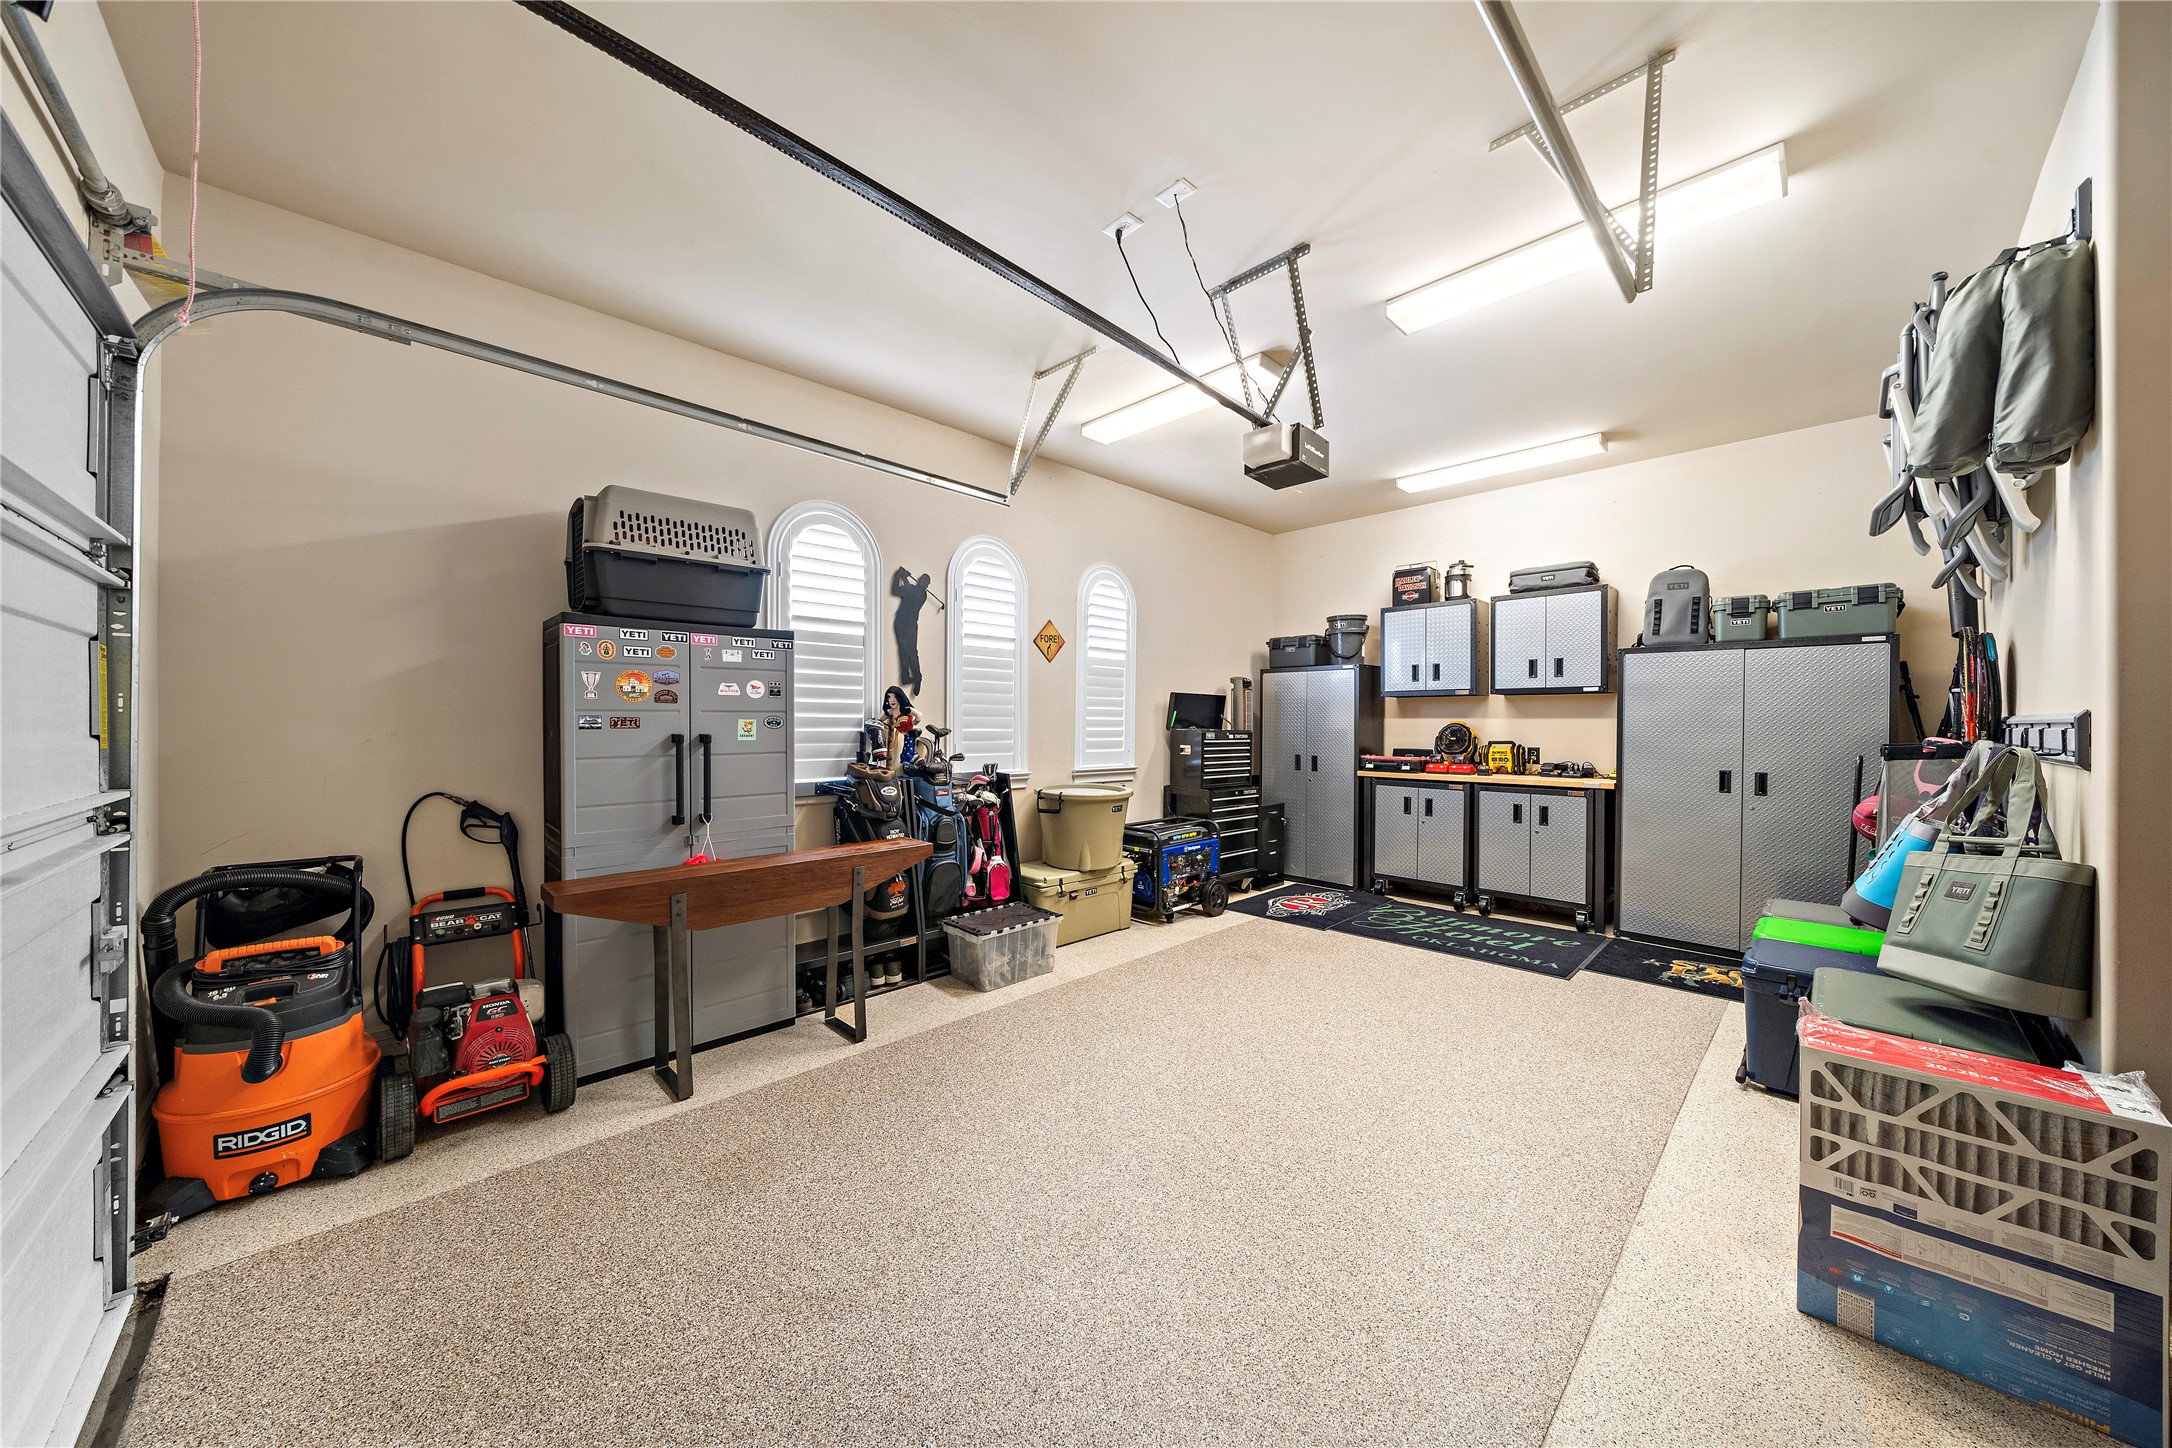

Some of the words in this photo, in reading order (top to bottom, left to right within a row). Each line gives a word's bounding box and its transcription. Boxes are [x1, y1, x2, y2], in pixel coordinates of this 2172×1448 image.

[566, 626, 594, 636] YETI
[621, 630, 646, 639] YETI
[663, 633, 687, 642] YETI
[693, 635, 716, 644] YETI
[1040, 634, 1060, 643] FORE!
[773, 641, 792, 649] YETI
[625, 647, 650, 656] YETI
[753, 651, 774, 659] YETI
[1086, 888, 1097, 896] YETI
[1951, 886, 1970, 894] YETI
[431, 919, 464, 928] BEAR
[479, 913, 502, 921] CAT
[1352, 920, 1535, 951] Hotel
[1412, 935, 1559, 969] OKLAHOMA
[482, 1000, 511, 1009] HONDA
[486, 1005, 508, 1016] GC
[1807, 1036, 1875, 1055] Filtrete
[217, 1119, 307, 1151] RIDGID
[2034, 1345, 2064, 1358] HOME
[2064, 1361, 2083, 1370] GET
[2066, 1356, 2110, 1376] FRESHER
[2085, 1370, 2110, 1381] HELP
